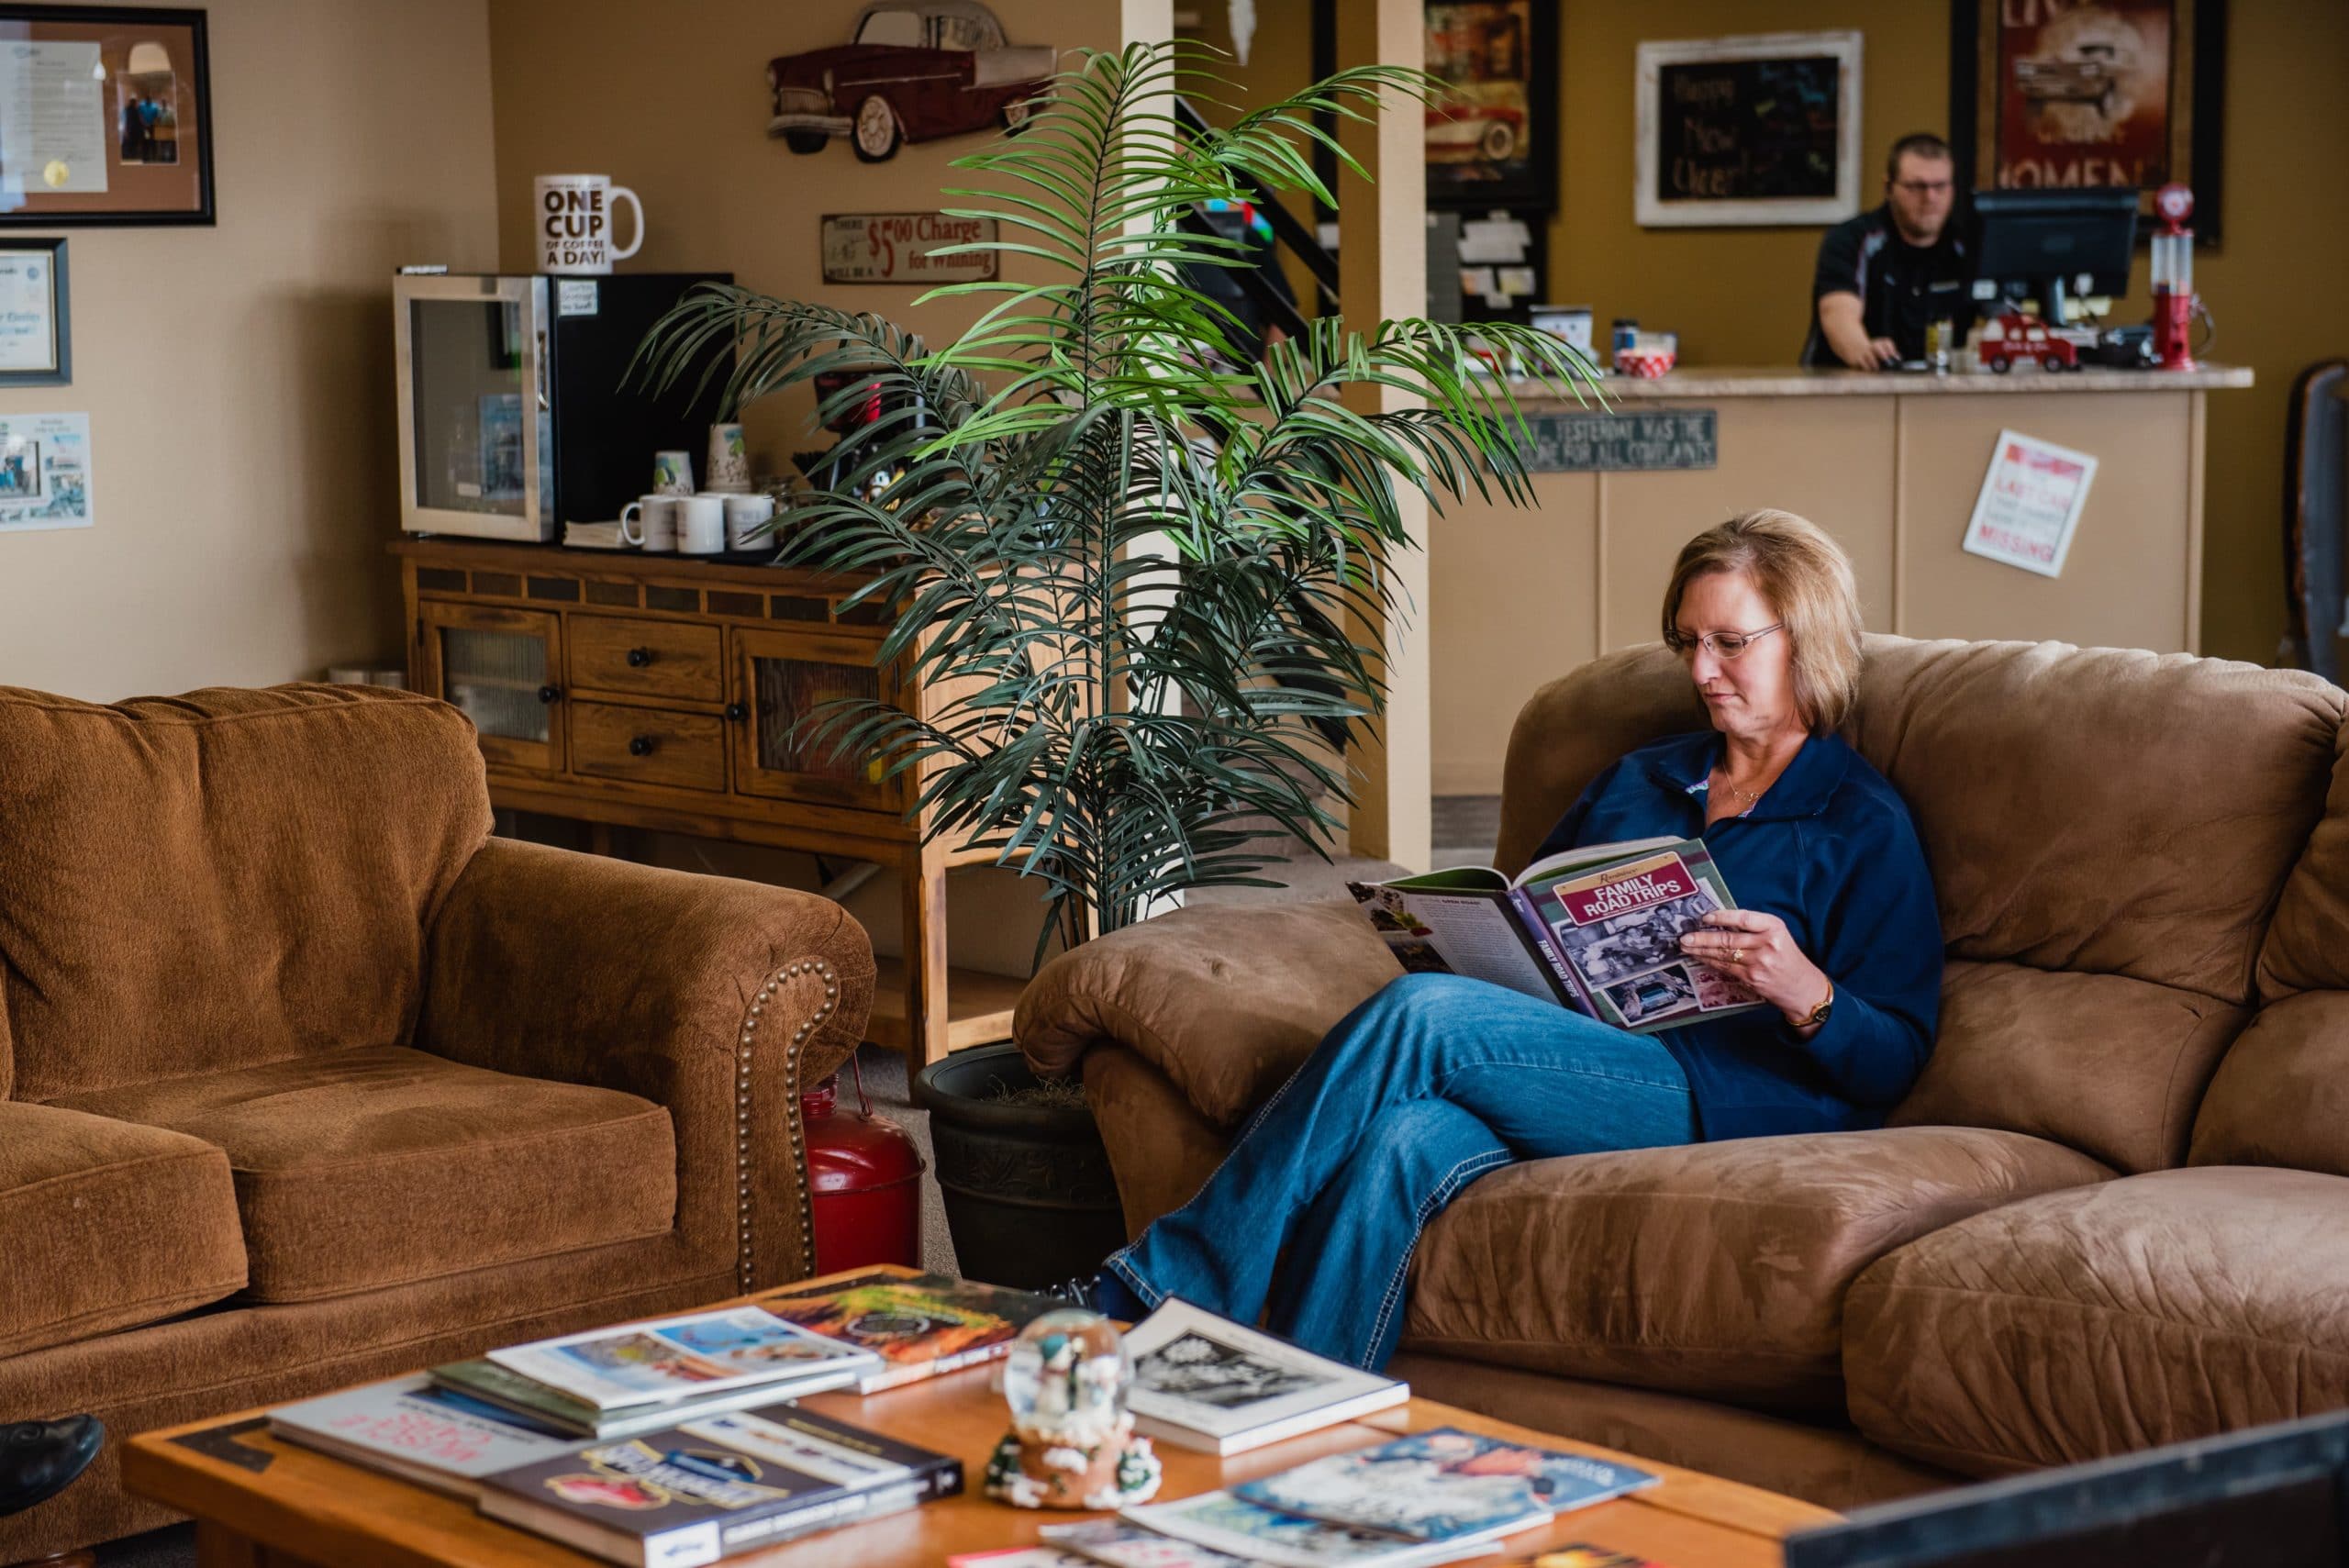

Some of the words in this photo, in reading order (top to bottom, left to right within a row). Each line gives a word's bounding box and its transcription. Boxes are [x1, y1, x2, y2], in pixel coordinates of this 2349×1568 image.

[544, 190, 602, 213] ONE
[545, 215, 603, 239] CUP
[918, 216, 982, 244] Charge
[546, 241, 559, 250] OF
[563, 240, 604, 250] COFFEE
[548, 251, 558, 265] A
[563, 251, 605, 265] DAY!
[908, 250, 927, 269] for
[1556, 418, 1634, 442] YESTERDAY
[1642, 418, 1675, 440] WAS
[1679, 417, 1706, 440] THE
[1627, 440, 1712, 462] COMPLAINTS
[1979, 524, 2054, 562] MISSING
[1583, 895, 1631, 917] ROAD
[1629, 880, 1682, 903] TRIPS
[1594, 874, 1654, 901] FAMILY
[1537, 940, 1558, 962] FAMILY
[1551, 962, 1568, 980] ROAD
[1563, 979, 1579, 998] TRIPS
